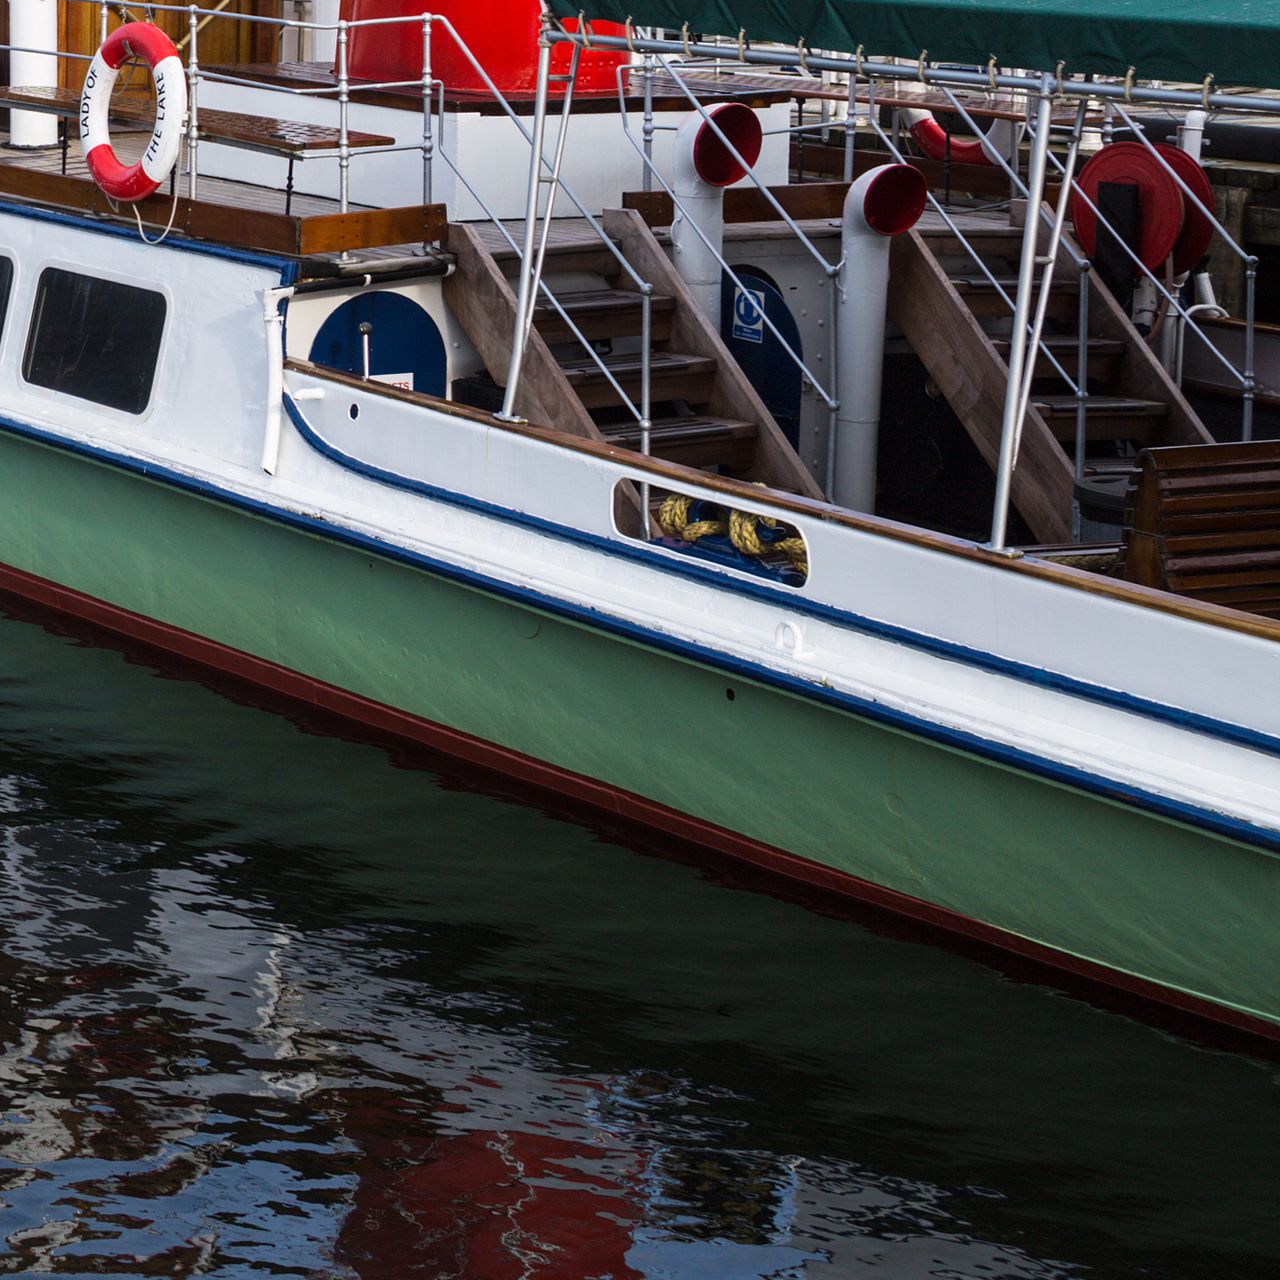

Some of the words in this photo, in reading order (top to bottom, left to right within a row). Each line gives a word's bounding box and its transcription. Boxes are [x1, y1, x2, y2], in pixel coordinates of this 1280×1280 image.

[81, 91, 91, 138] LADY
[87, 66, 98, 88] OF
[146, 130, 162, 161] THE
[157, 72, 166, 120] LAKE
